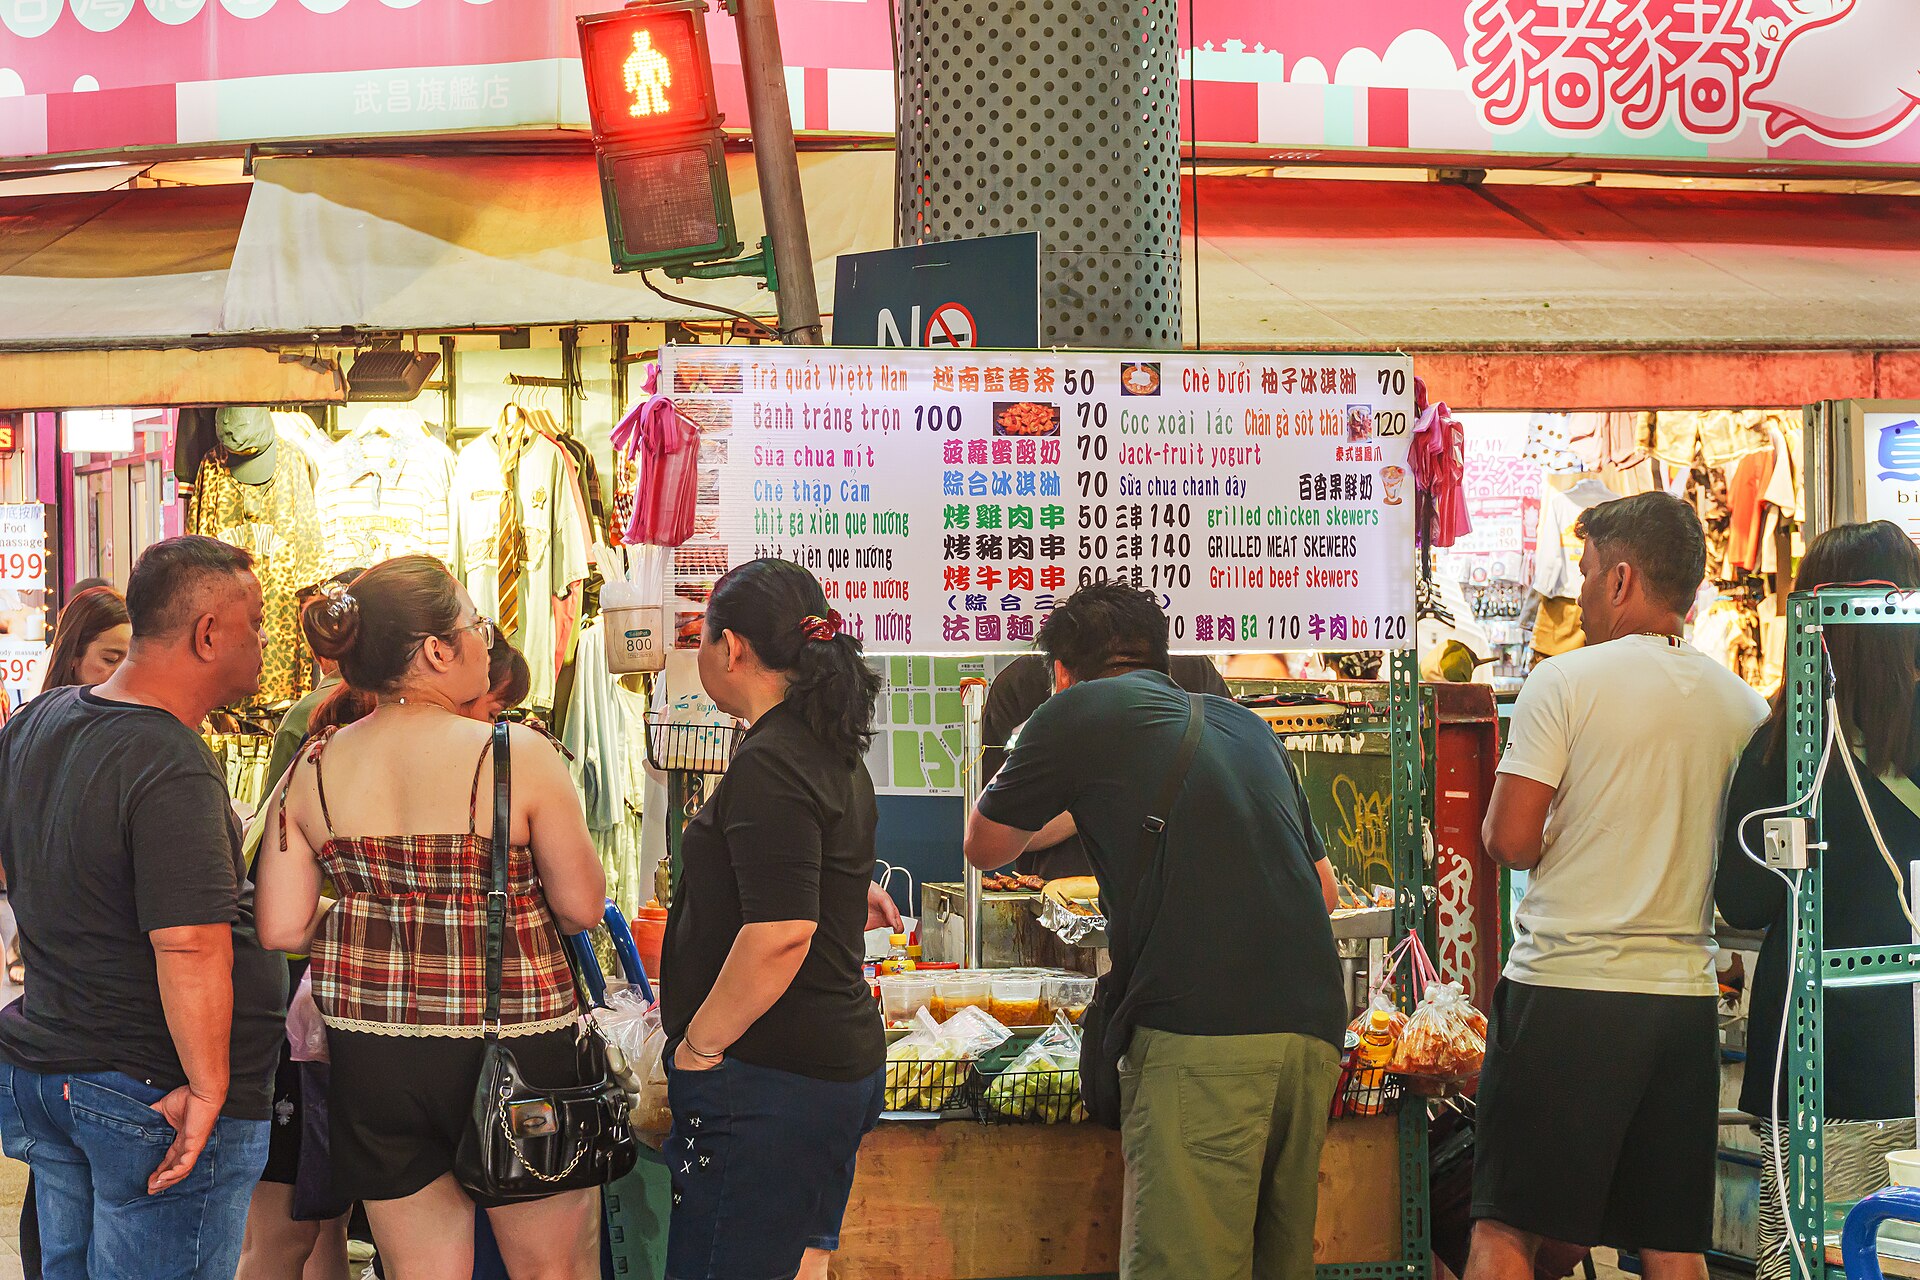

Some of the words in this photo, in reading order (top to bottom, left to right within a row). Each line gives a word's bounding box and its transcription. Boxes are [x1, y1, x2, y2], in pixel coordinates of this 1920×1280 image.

[353, 75, 510, 114] 武昌旗艦店
[751, 363, 777, 390] Trà
[881, 365, 908, 391] Nam
[1063, 369, 1094, 395] 50
[1183, 367, 1209, 393] Chè
[1218, 361, 1251, 393] bưởi
[1261, 367, 1357, 395] 柚子冰淇淋
[1377, 369, 1405, 395] 70
[754, 402, 793, 430] Bánh
[802, 402, 852, 433] tráng
[914, 405, 962, 432] 100
[1077, 402, 1107, 428] 70
[1158, 410, 1194, 435] xoài
[1207, 408, 1233, 435] lác
[1245, 408, 1271, 436] Chân
[1276, 409, 1289, 438] gà
[1319, 409, 1344, 436] thái
[1374, 411, 1406, 437] 120
[794, 445, 835, 467] chua
[844, 444, 874, 467] mít
[943, 439, 1060, 465] 菠蘿蜜酸奶
[1077, 434, 1108, 461] 70
[1119, 443, 1204, 465] Jack-fruit
[1211, 443, 1261, 468] yogurt
[754, 479, 783, 502] Chè
[793, 478, 831, 507] thập
[943, 470, 1060, 497] 綜合冰淇淋
[1077, 471, 1108, 497] 70
[1148, 476, 1176, 496] chua
[1183, 476, 1218, 496] chanh
[1226, 475, 1246, 498] dây
[1299, 473, 1372, 501] 百香果鮮奶
[4, 523, 26, 533] Foot
[754, 508, 783, 541] thịt
[810, 508, 838, 534] xiên
[845, 512, 867, 538] que
[943, 504, 1065, 530] 烤雞肉串
[1078, 504, 1108, 529] 50
[1115, 503, 1142, 530] 三串
[1151, 503, 1190, 528] 140
[1207, 506, 1261, 528] grilled
[1267, 506, 1320, 526] chicken
[1326, 506, 1379, 526] skewers
[793, 544, 822, 569] xiên
[828, 549, 849, 572] que
[943, 534, 1066, 561] 烤豬肉串
[1078, 535, 1108, 559] 50
[1115, 534, 1142, 560] 三串
[1151, 534, 1191, 558] 140
[1208, 535, 1261, 558] GRILLED
[1267, 535, 1298, 558] MEAT
[1303, 535, 1357, 558] SKEWERS
[845, 580, 867, 602] que
[943, 565, 1066, 591] 烤牛肉串
[1151, 564, 1191, 589] 170
[1209, 566, 1263, 589] Grilled
[1269, 566, 1299, 589] beef
[1306, 566, 1359, 589] skewers
[942, 614, 1050, 641] 法國麵
[1196, 614, 1235, 642] 雞肉
[1268, 616, 1300, 639] 110
[1308, 614, 1347, 641] 牛肉
[1374, 616, 1406, 639] 120
[626, 638, 652, 652] 800
